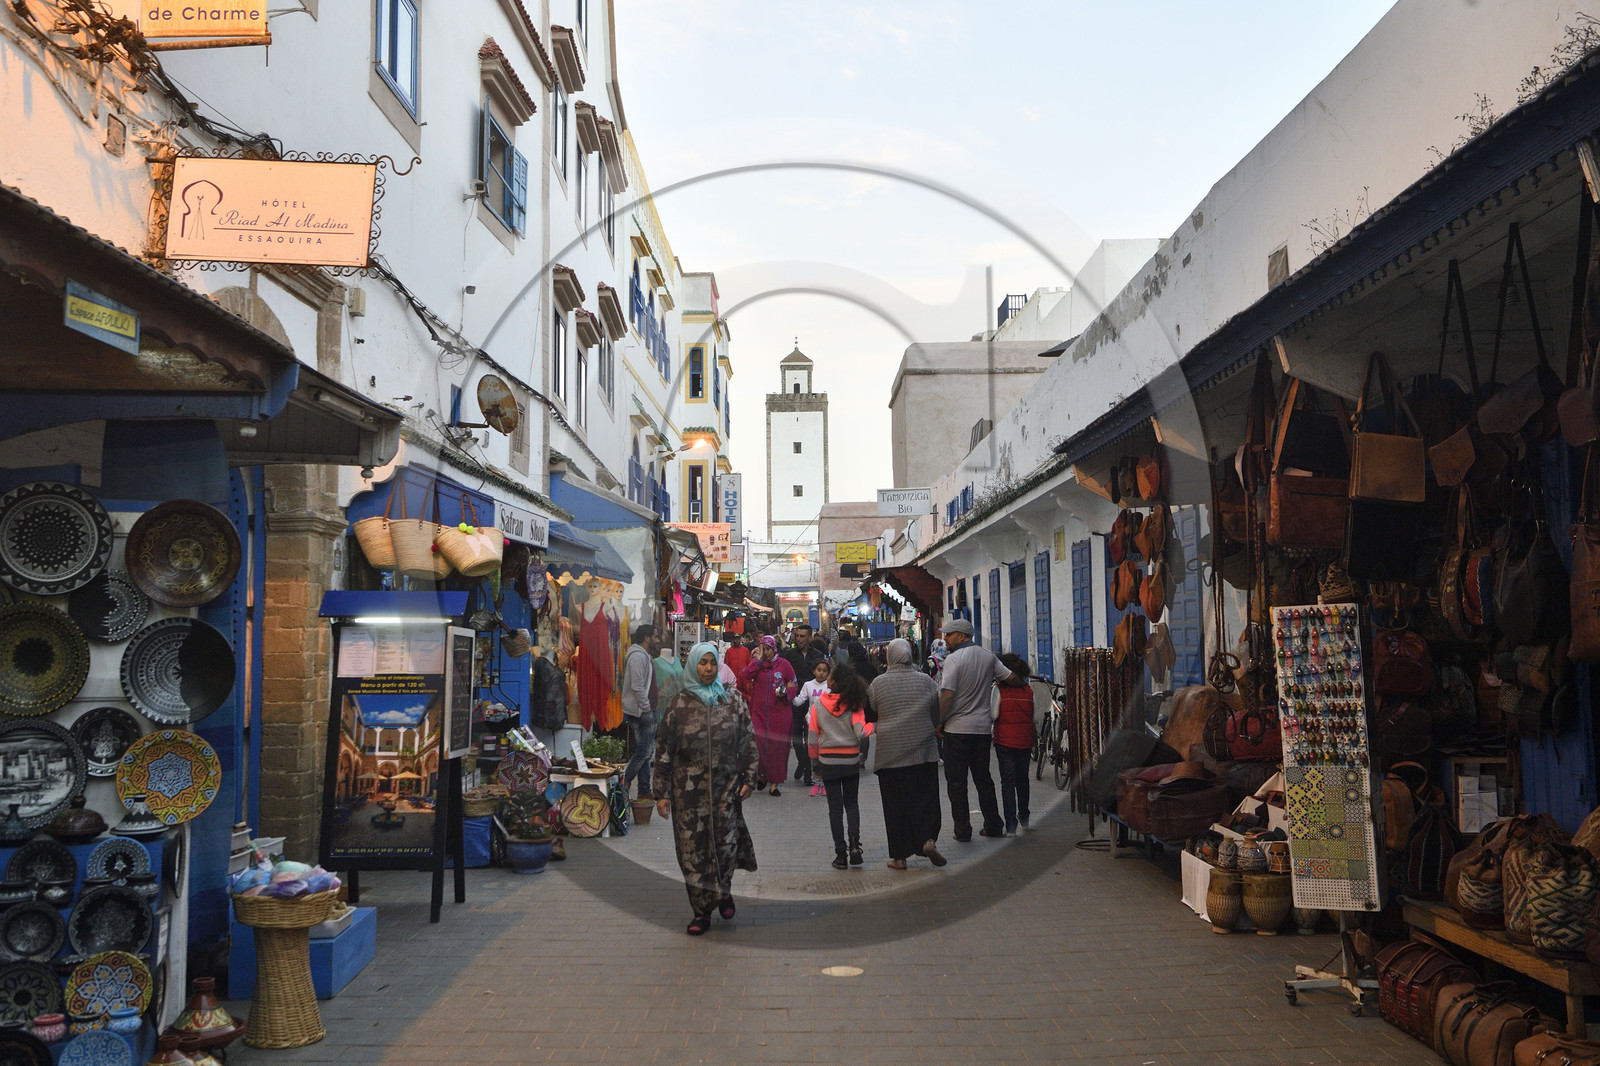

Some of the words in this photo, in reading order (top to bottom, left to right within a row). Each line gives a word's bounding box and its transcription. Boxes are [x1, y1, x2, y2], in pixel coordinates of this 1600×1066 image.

[148, 7, 172, 21] de
[182, 6, 260, 21] Charme
[218, 209, 260, 226] Riad
[265, 212, 290, 228] Al
[295, 213, 349, 229] Madina
[238, 234, 322, 244] ESSAOUIRA
[724, 490, 738, 532] HOTE
[500, 508, 524, 537] Safran
